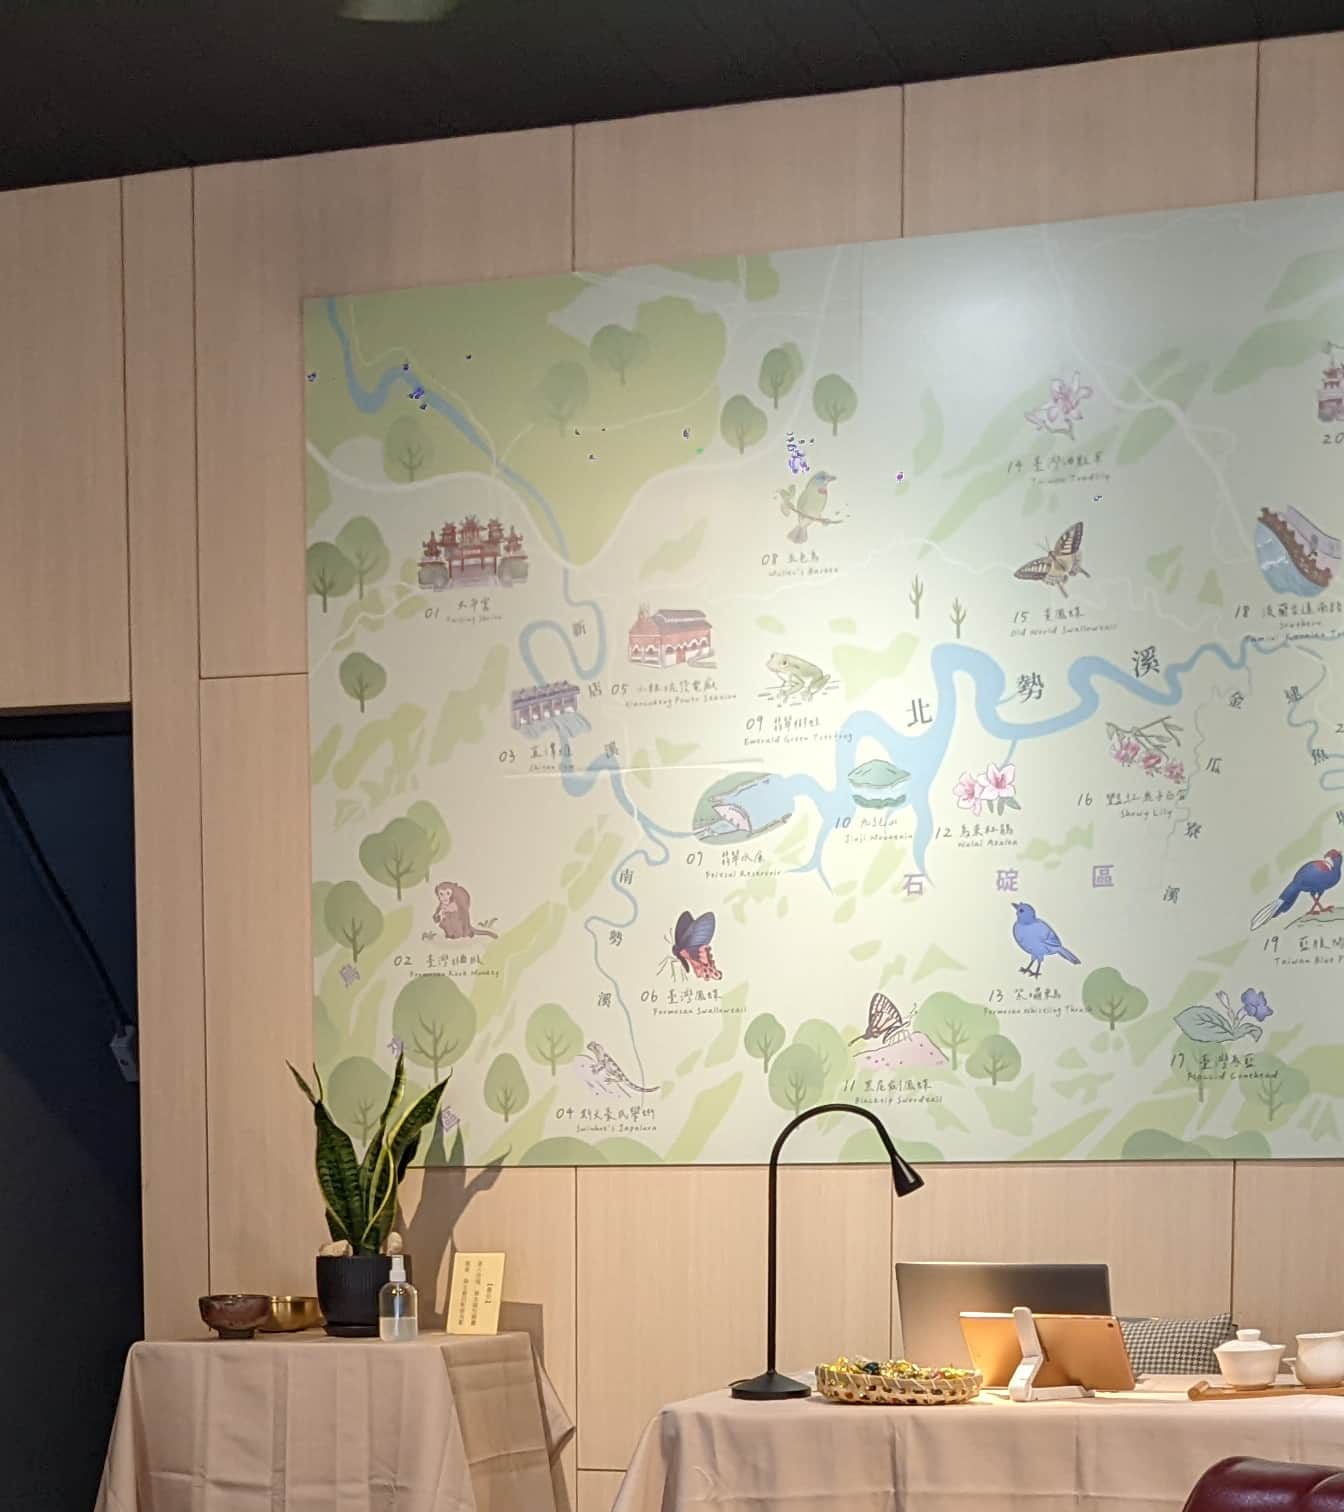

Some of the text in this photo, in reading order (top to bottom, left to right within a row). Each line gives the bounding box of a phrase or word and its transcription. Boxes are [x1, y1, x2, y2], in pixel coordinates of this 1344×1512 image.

[1322, 432, 1344, 445] 20
[1007, 460, 1023, 473] 14
[761, 553, 778, 566] 08
[424, 608, 440, 619] 01
[1013, 611, 1029, 623] 15
[1234, 604, 1250, 619] 18
[610, 683, 630, 696] 05
[905, 645, 1161, 728] 北 勢 溪
[745, 714, 763, 731] 09
[498, 749, 516, 763] 03
[1077, 792, 1093, 807] 16
[835, 816, 852, 829] 10
[935, 827, 953, 839] 12
[686, 850, 704, 867] 07
[619, 868, 634, 885] 南
[903, 864, 1115, 896] 石 碇 區
[1263, 935, 1279, 952] 19
[393, 955, 414, 967] 02
[640, 990, 658, 1003] 06
[988, 988, 1004, 1002] 13
[1170, 1053, 1185, 1068] 17
[843, 1079, 856, 1092] 11
[555, 1107, 574, 1120] 04
